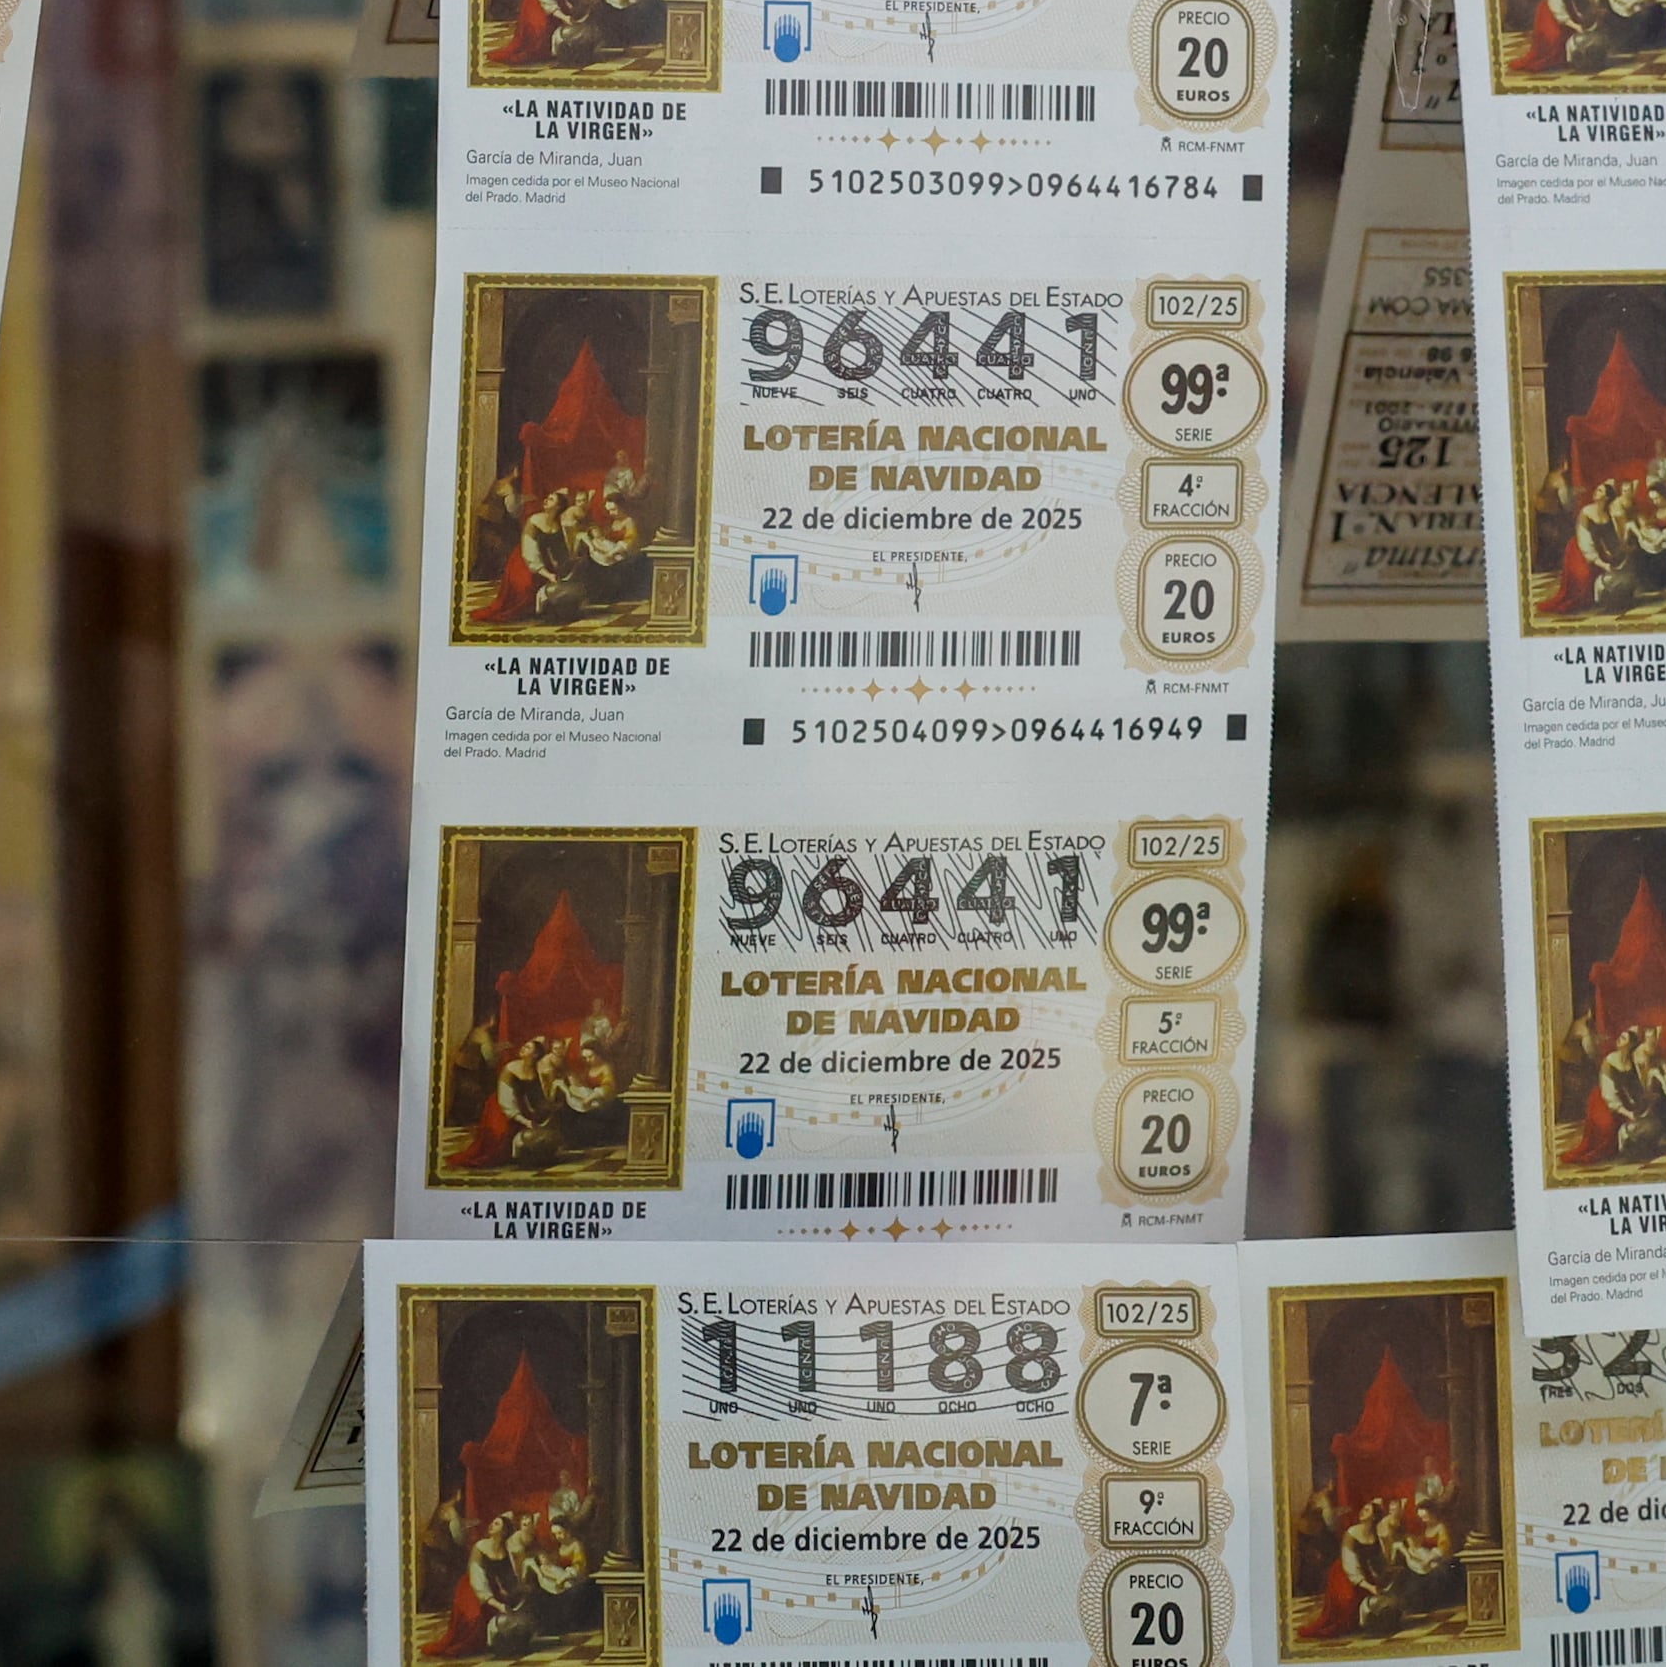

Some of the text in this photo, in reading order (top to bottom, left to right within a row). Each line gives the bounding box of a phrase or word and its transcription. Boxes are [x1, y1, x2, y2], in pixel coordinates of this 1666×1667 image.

[885, 0, 981, 16] EL PRESIDENTE,
[1177, 10, 1231, 26] PRECIO
[1177, 36, 1229, 79] 20
[502, 98, 687, 121] «LA NATIVIDAD DE
[1176, 89, 1231, 103] EUROS
[535, 120, 654, 141] LA VIRGEN»
[466, 149, 643, 168] García de Miranda, Juan
[1178, 140, 1246, 153] RCM-FNMT
[465, 173, 680, 189] Imagen cedida por el Museo Nacional
[809, 168, 1219, 200] 5102503099>0964416784
[464, 190, 566, 204] del Prado. Madrid
[747, 309, 1100, 383] 96441
[1364, 365, 1461, 383] Valencia
[742, 418, 1109, 453] LOTERÍA NACIONAL
[1377, 435, 1453, 469] 125
[808, 464, 1043, 493] DE NAVIDAD
[1163, 578, 1216, 620] 20
[791, 716, 1204, 748] 5102504099>0964416949
[726, 856, 1084, 930] 96441
[720, 962, 1089, 998] LOTERÍA NACIONAL
[786, 1007, 1022, 1037] DE NAVIDAD
[1139, 1113, 1193, 1155] 20
[1107, 1300, 1190, 1326] 102/25
[701, 1319, 1061, 1394] 11188
[687, 1434, 1064, 1471] LOTERÍA NACIONAL
[757, 1482, 998, 1513] DE NAVIDAD
[1130, 1601, 1184, 1647] 20
